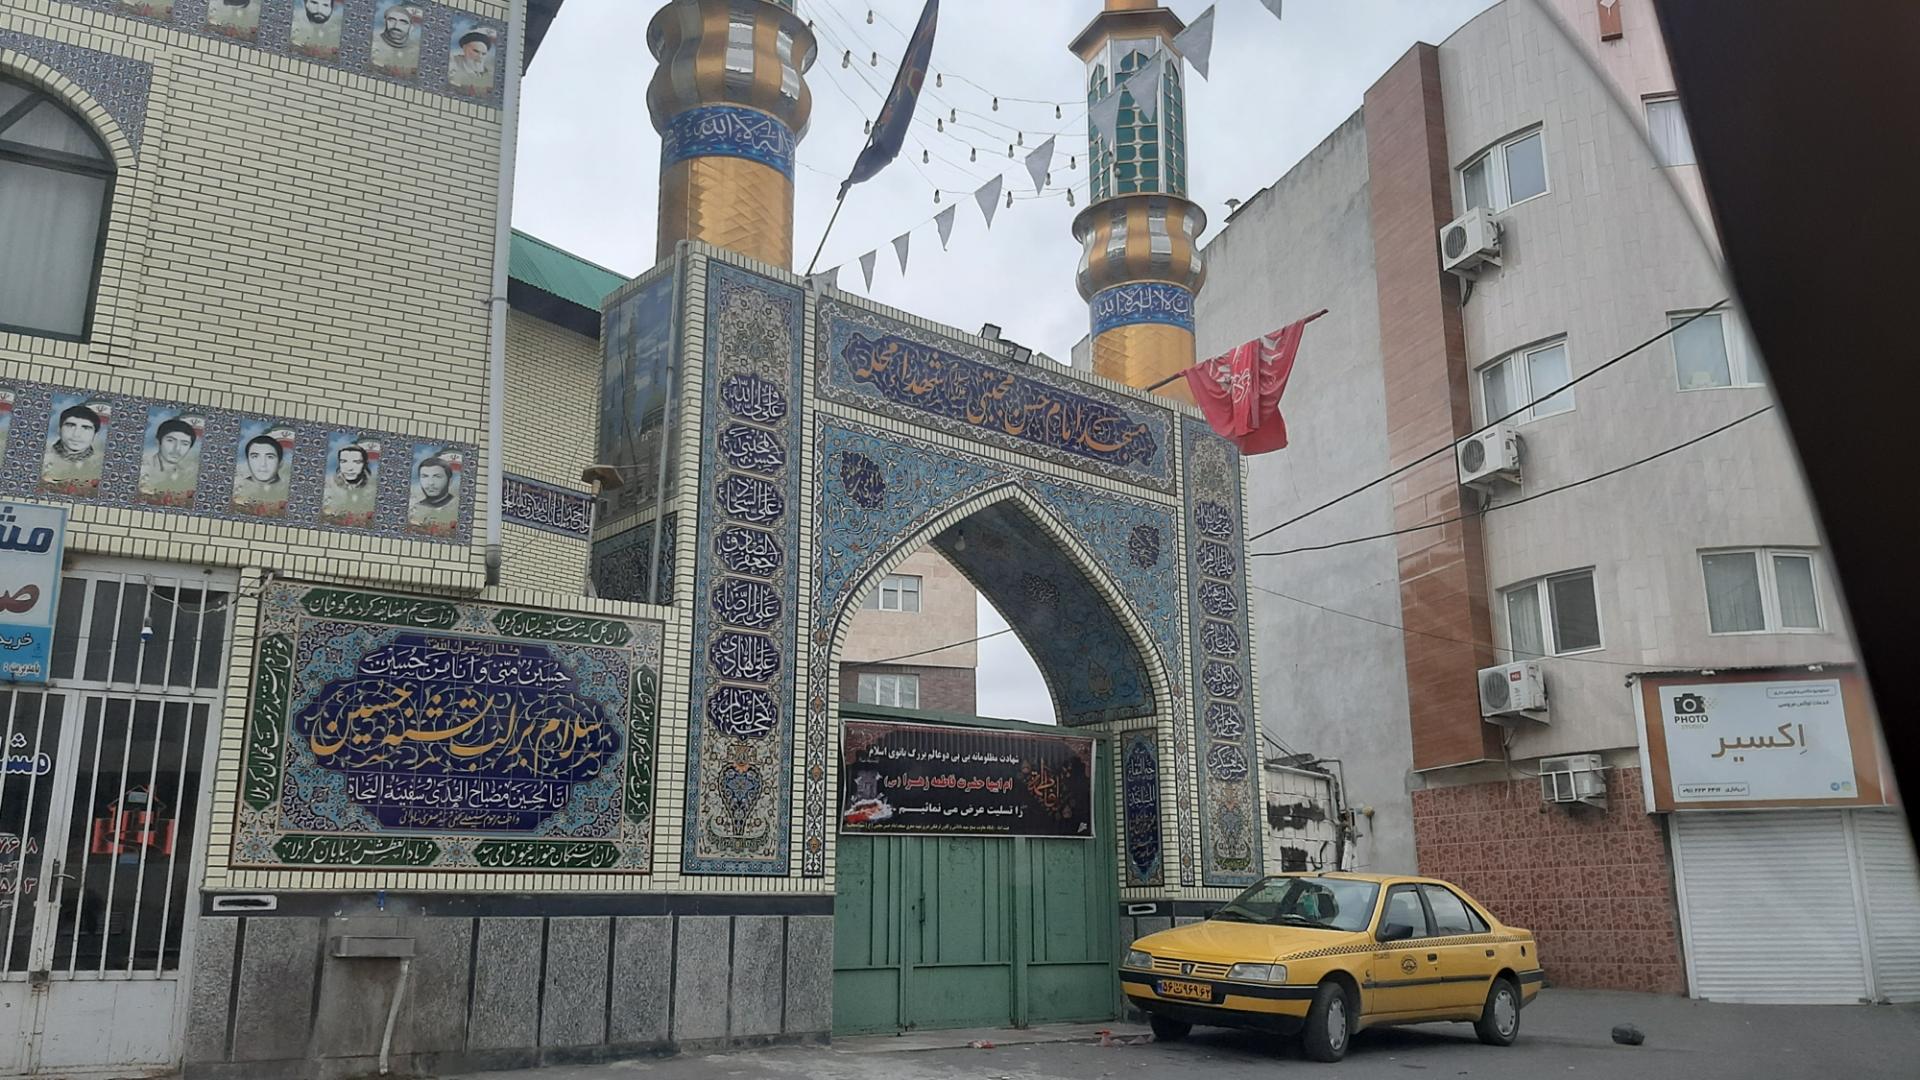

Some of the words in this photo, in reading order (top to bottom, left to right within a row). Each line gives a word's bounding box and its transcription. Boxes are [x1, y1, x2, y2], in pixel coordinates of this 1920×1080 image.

[310, 686, 413, 756] حسین
[1674, 715, 1709, 724] PHOTO
[450, 704, 517, 772] لب
[507, 719, 537, 767] بر
[535, 712, 602, 777] سلام
[868, 746, 887, 758] اسلام
[956, 777, 986, 793] حضرت
[960, 804, 985, 817] عرض
[986, 805, 1013, 817] تسلیت
